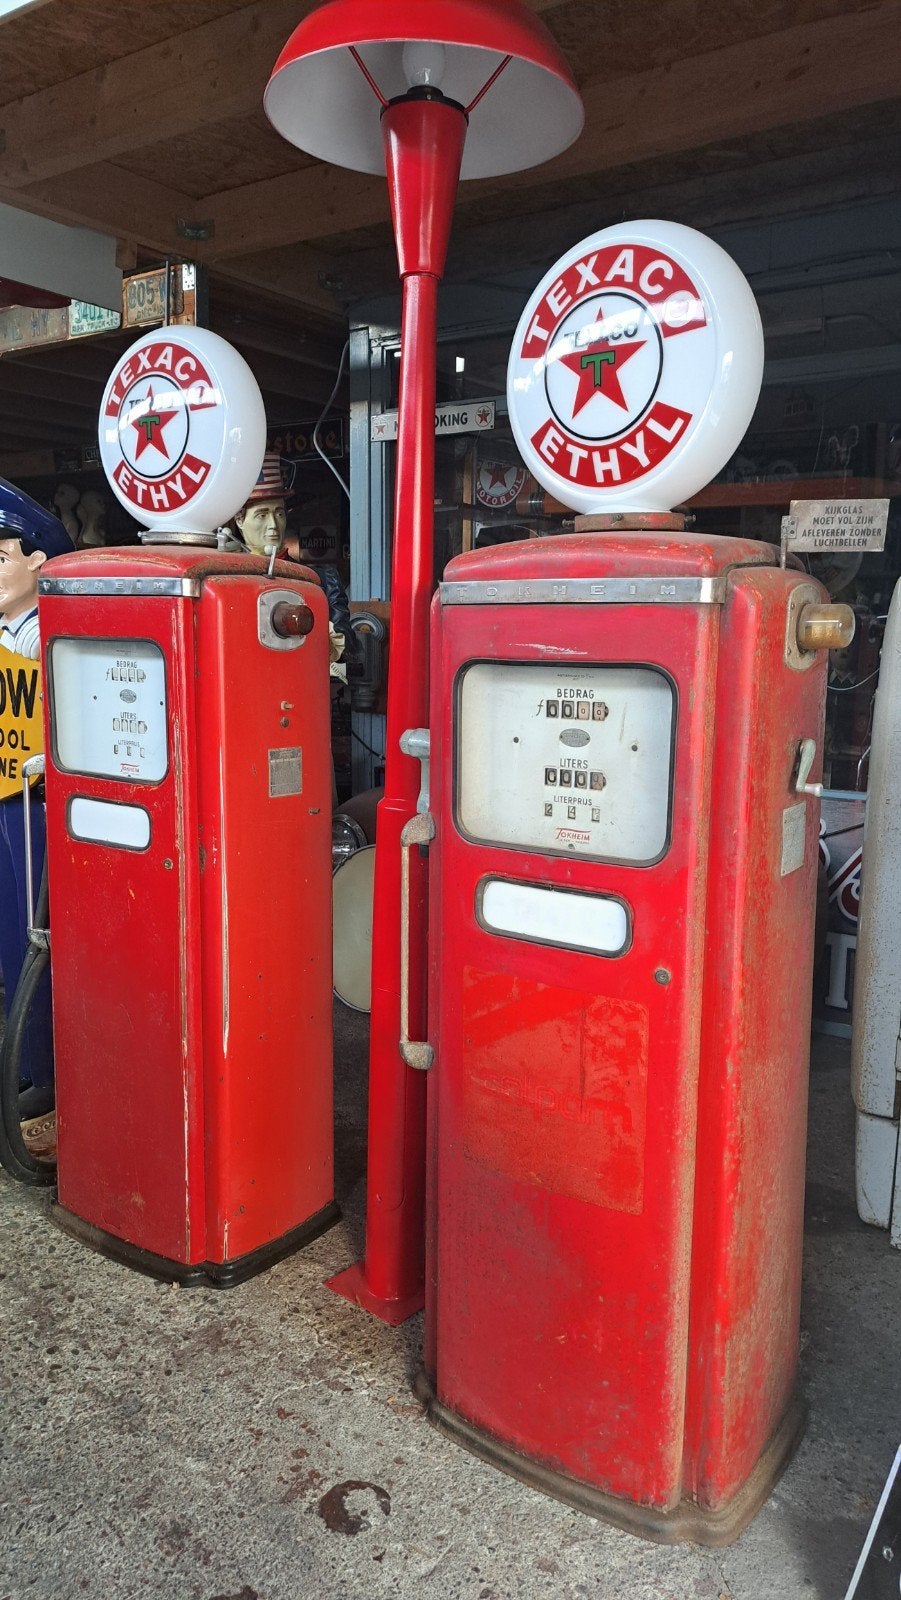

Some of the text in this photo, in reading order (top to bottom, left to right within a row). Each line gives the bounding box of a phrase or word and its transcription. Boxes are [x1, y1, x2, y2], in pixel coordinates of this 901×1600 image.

[526, 249, 702, 345] TEXACO
[581, 351, 616, 388] T
[138, 415, 161, 441] T
[540, 416, 684, 483] ETHYL
[119, 464, 206, 509] ETHYL
[825, 505, 863, 514] KIJKGLAS
[813, 516, 873, 525] MOET VOL ZIJN
[802, 528, 882, 537] AFLEVEREN ZONDER
[301, 537, 335, 549] MARTINI
[814, 538, 867, 547] LUCHTBELLEN
[457, 585, 676, 597] TOKHEIM
[557, 688, 594, 699] BEDRAG
[559, 757, 589, 769] LITERS
[553, 795, 592, 806] LITERPRIJS
[556, 828, 591, 840] TOKHEIM
